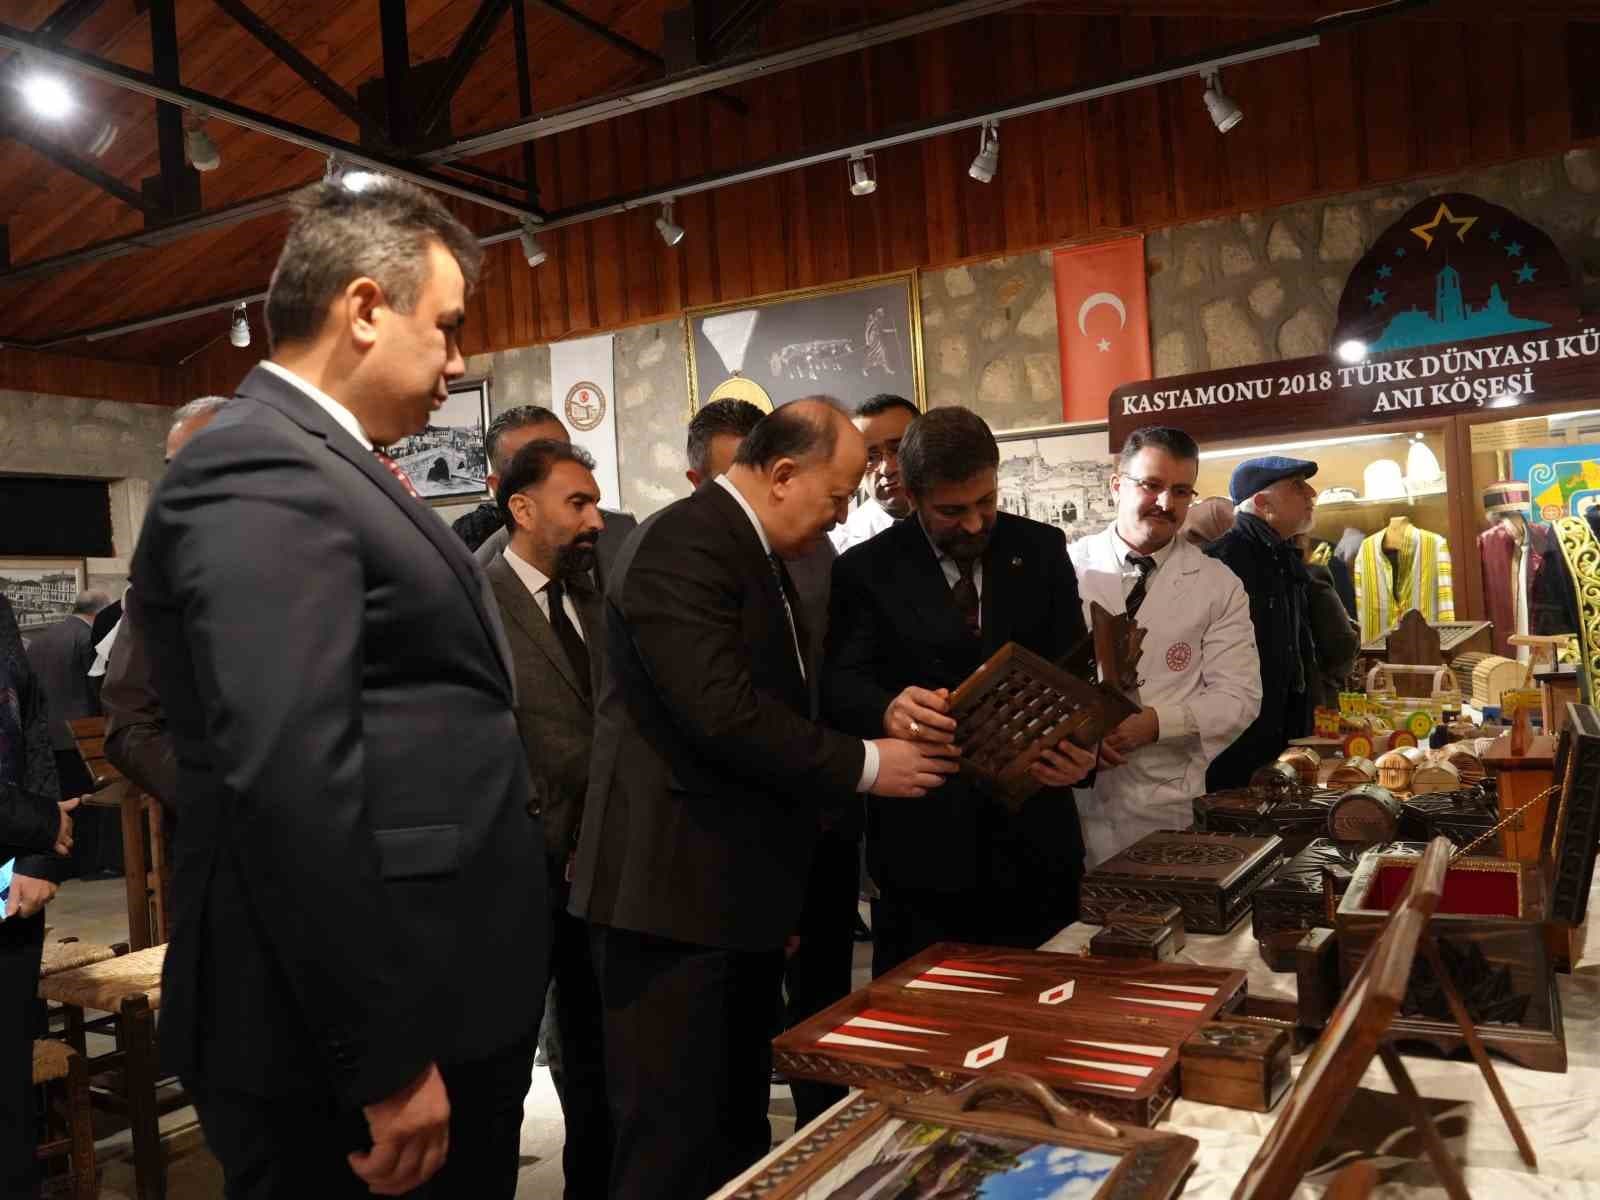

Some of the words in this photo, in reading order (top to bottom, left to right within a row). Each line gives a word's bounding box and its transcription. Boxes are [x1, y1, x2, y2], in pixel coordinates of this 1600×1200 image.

[1122, 379, 1273, 416] KASTAMONU
[1278, 371, 1333, 396] 2018
[1338, 359, 1416, 388] TÜRK
[1420, 340, 1550, 378] DÜNYASI
[1373, 386, 1425, 413] ANI
[1430, 367, 1536, 407] KÖŞESİ
